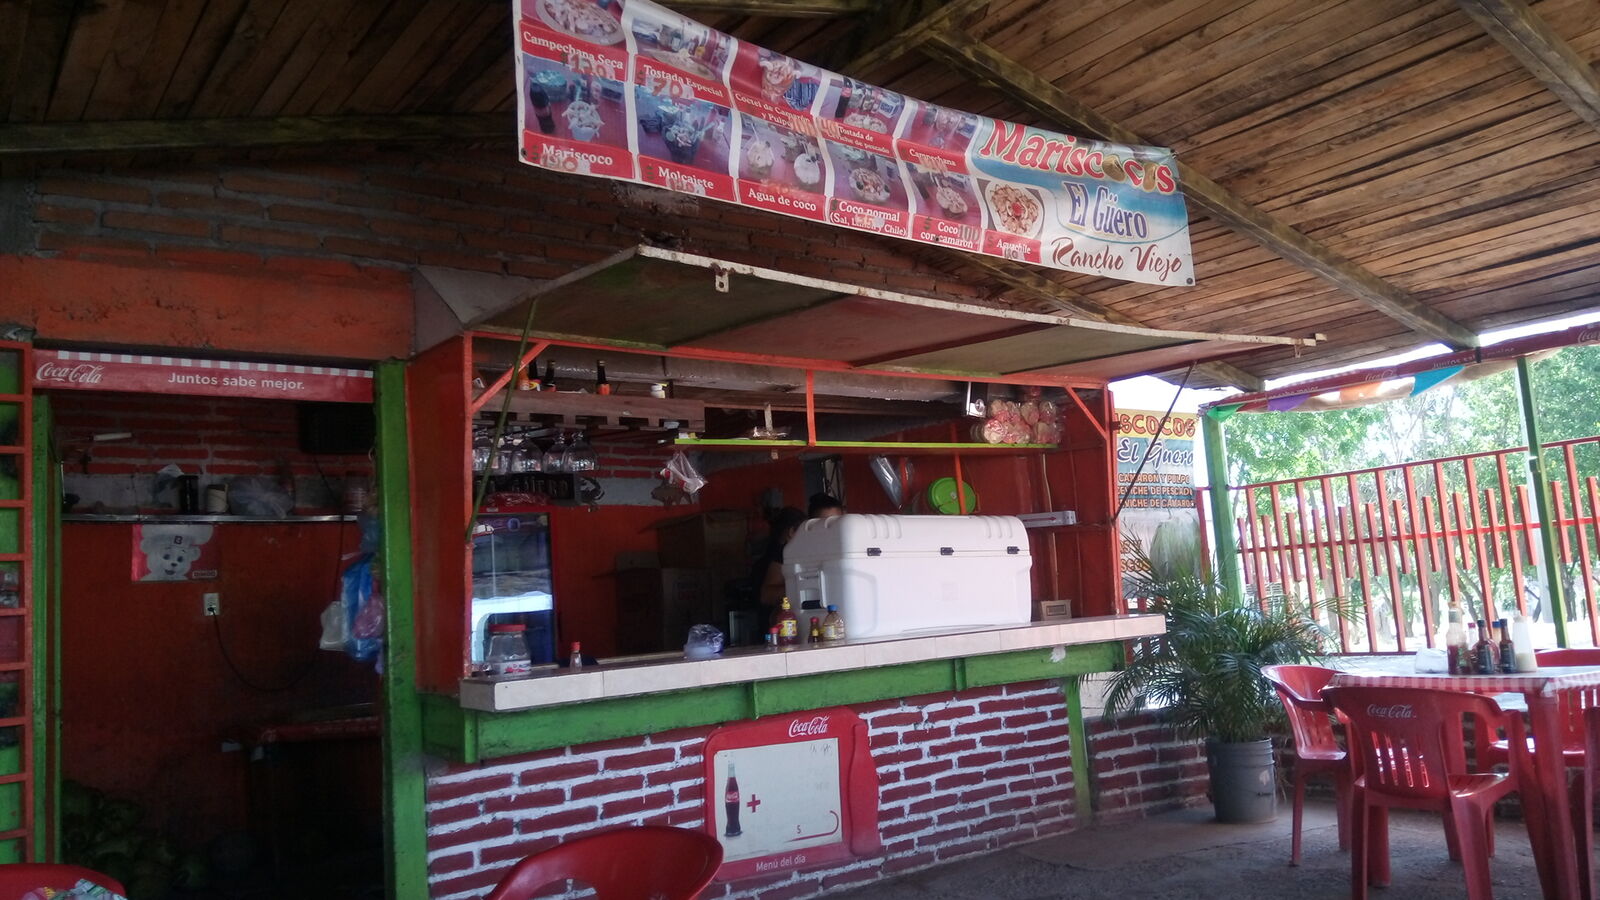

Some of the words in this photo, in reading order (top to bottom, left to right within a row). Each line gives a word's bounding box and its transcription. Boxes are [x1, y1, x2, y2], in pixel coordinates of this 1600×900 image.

[523, 31, 595, 61] Campechana
[597, 54, 624, 70] Seca
[643, 64, 685, 84] Tostada
[685, 78, 724, 98] Especial
[735, 93, 762, 108] Coctel
[542, 143, 613, 166] Mariscoco
[909, 148, 957, 167] Campechana
[748, 188, 775, 202] Agua
[778, 195, 791, 206] de
[793, 200, 817, 211] coco
[1063, 182, 1089, 227] El
[839, 201, 863, 214] Coco
[866, 208, 900, 222] normal
[884, 223, 907, 237] Chile)
[937, 221, 958, 235] Coco
[996, 239, 1031, 255] Aguachile
[1051, 236, 1124, 271] Rancho
[1129, 244, 1183, 282] Viejo
[36, 361, 105, 383] Coca-Cola
[168, 372, 218, 385] Juntos
[222, 376, 257, 387] sabe
[261, 378, 305, 391] mejor.
[1117, 438, 1139, 463] El
[1150, 486, 1161, 496] DE
[1150, 498, 1161, 508] DE
[1366, 703, 1413, 719] Coca-Cola
[788, 715, 830, 738] Coca-Cola
[756, 859, 779, 872] Menú
[780, 857, 792, 867] del
